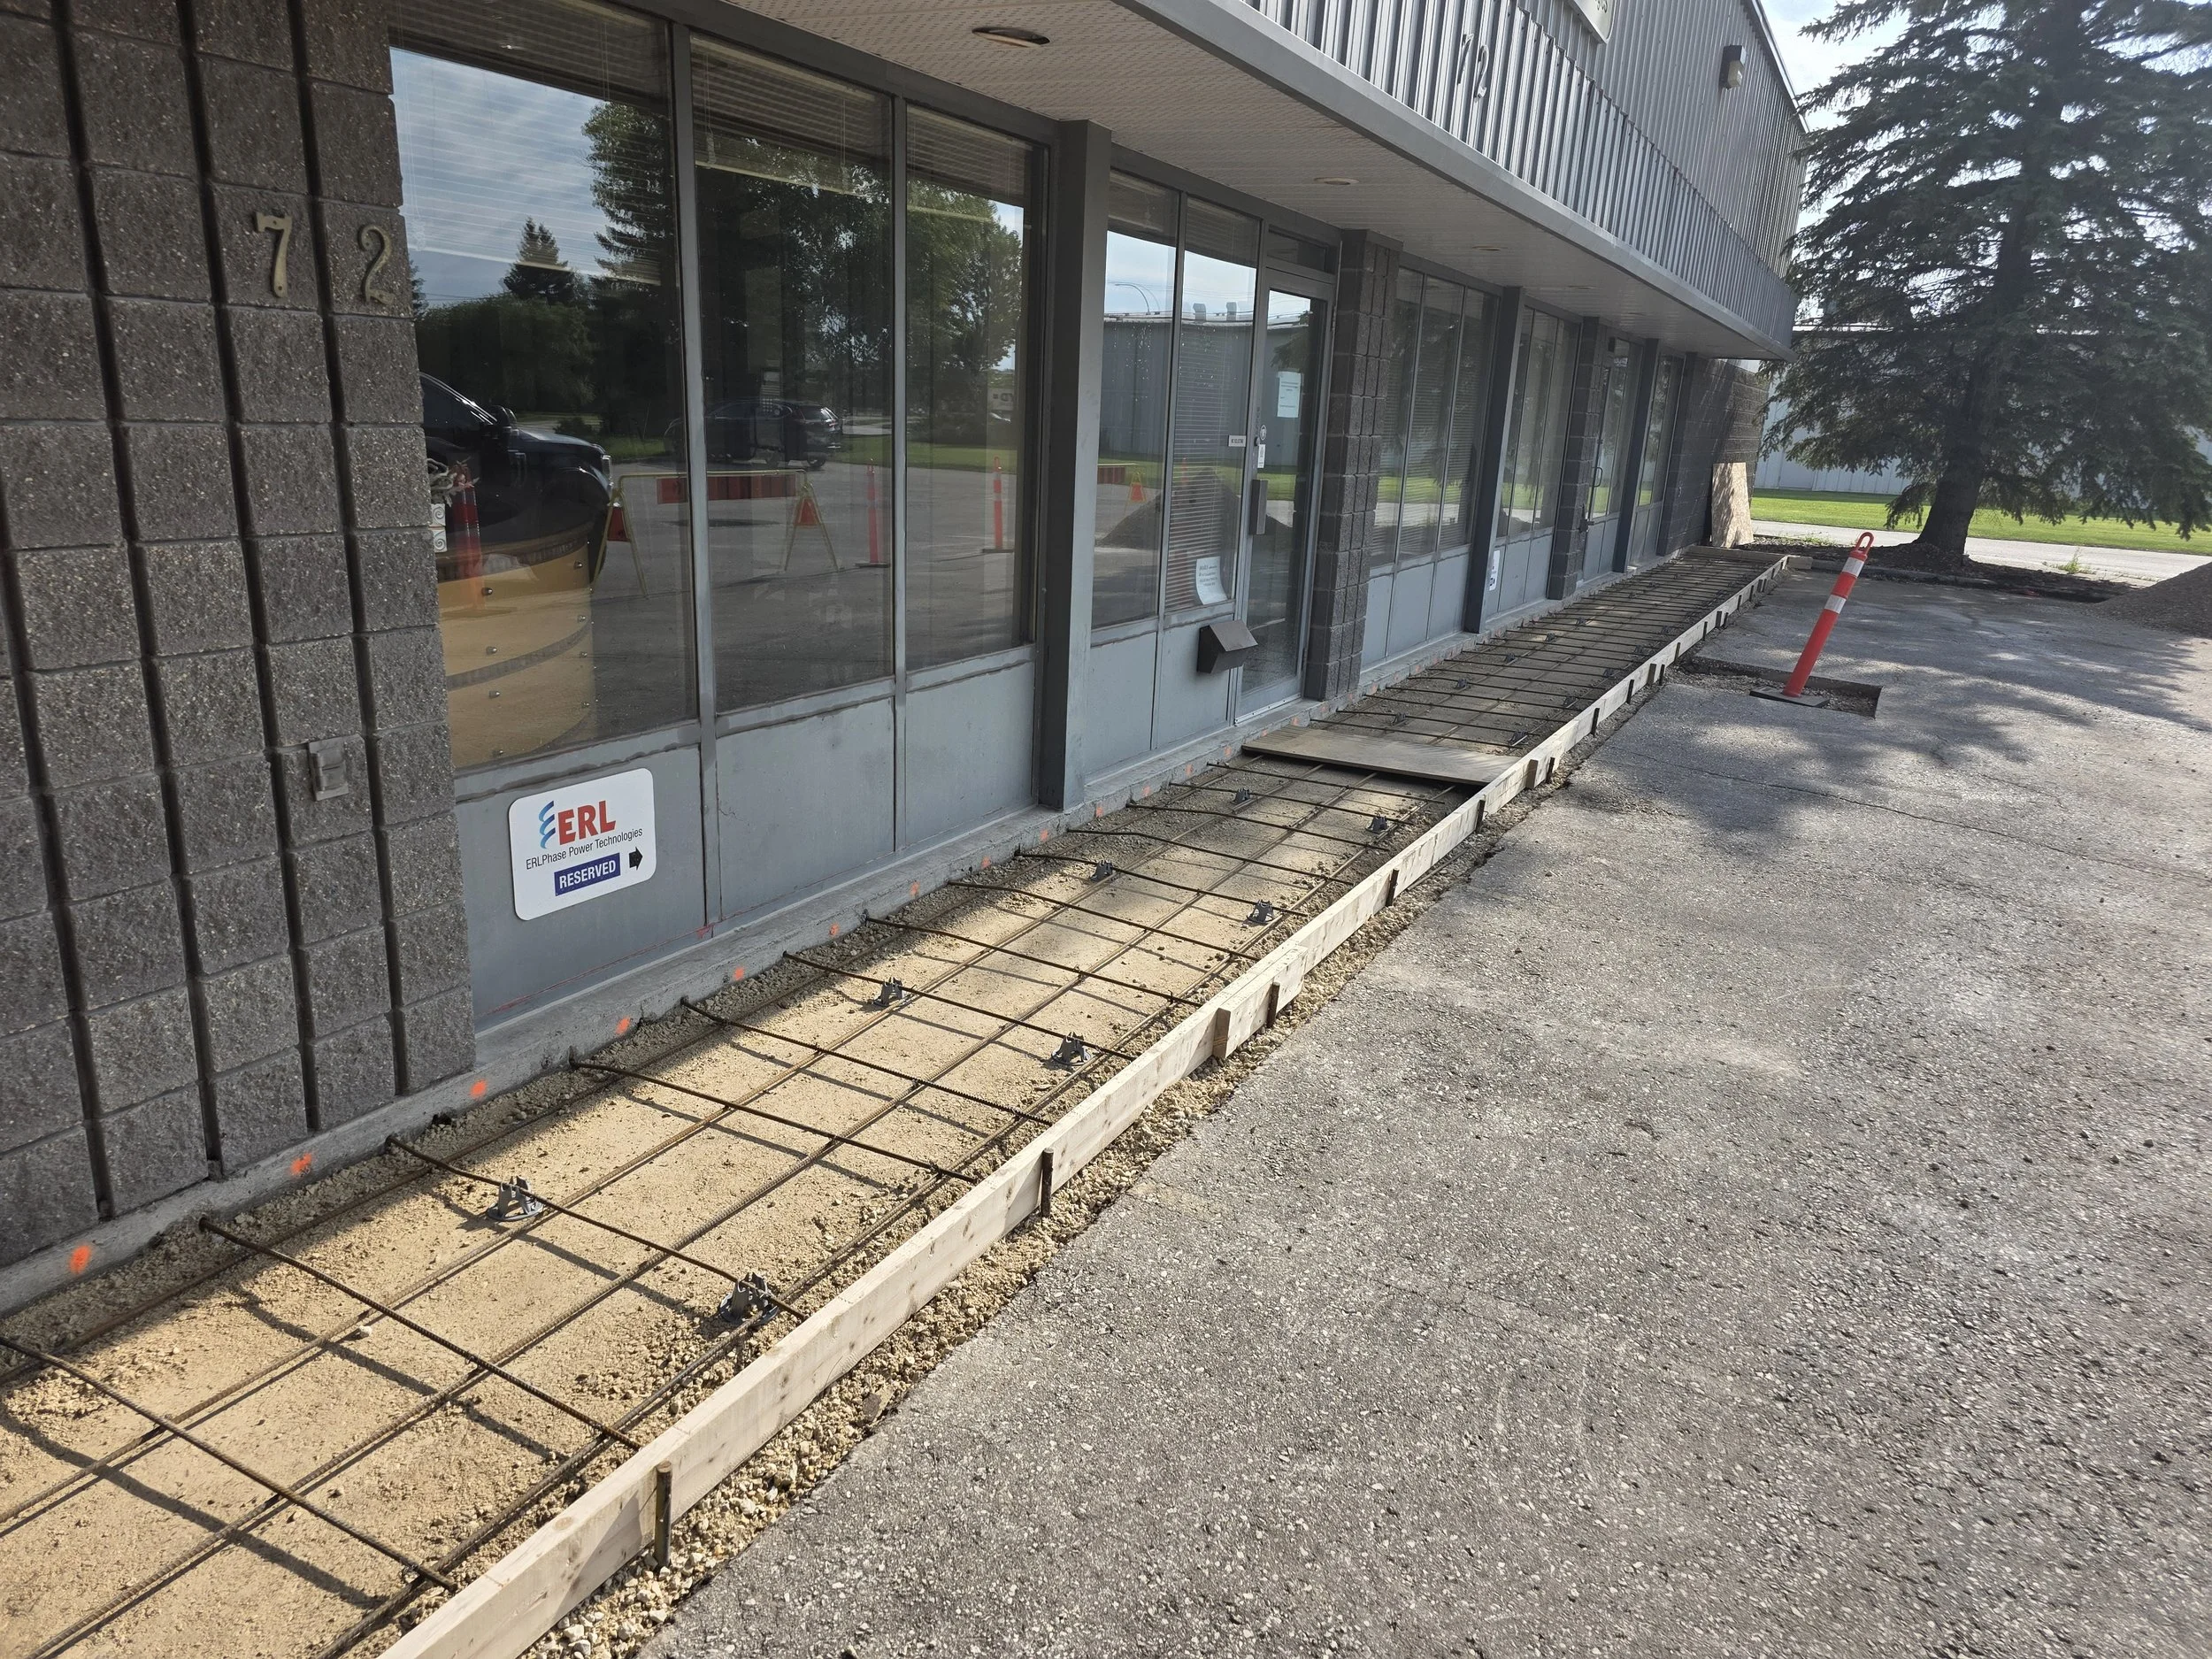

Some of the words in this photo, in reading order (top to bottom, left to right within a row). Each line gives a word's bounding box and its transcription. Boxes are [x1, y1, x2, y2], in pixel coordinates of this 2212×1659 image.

[1456, 33, 1490, 103] 72
[557, 800, 617, 846] ERL
[526, 851, 567, 871] ERLPhase
[569, 843, 594, 857] Power
[595, 828, 643, 849] Technologies
[558, 859, 617, 889] RESERVED
